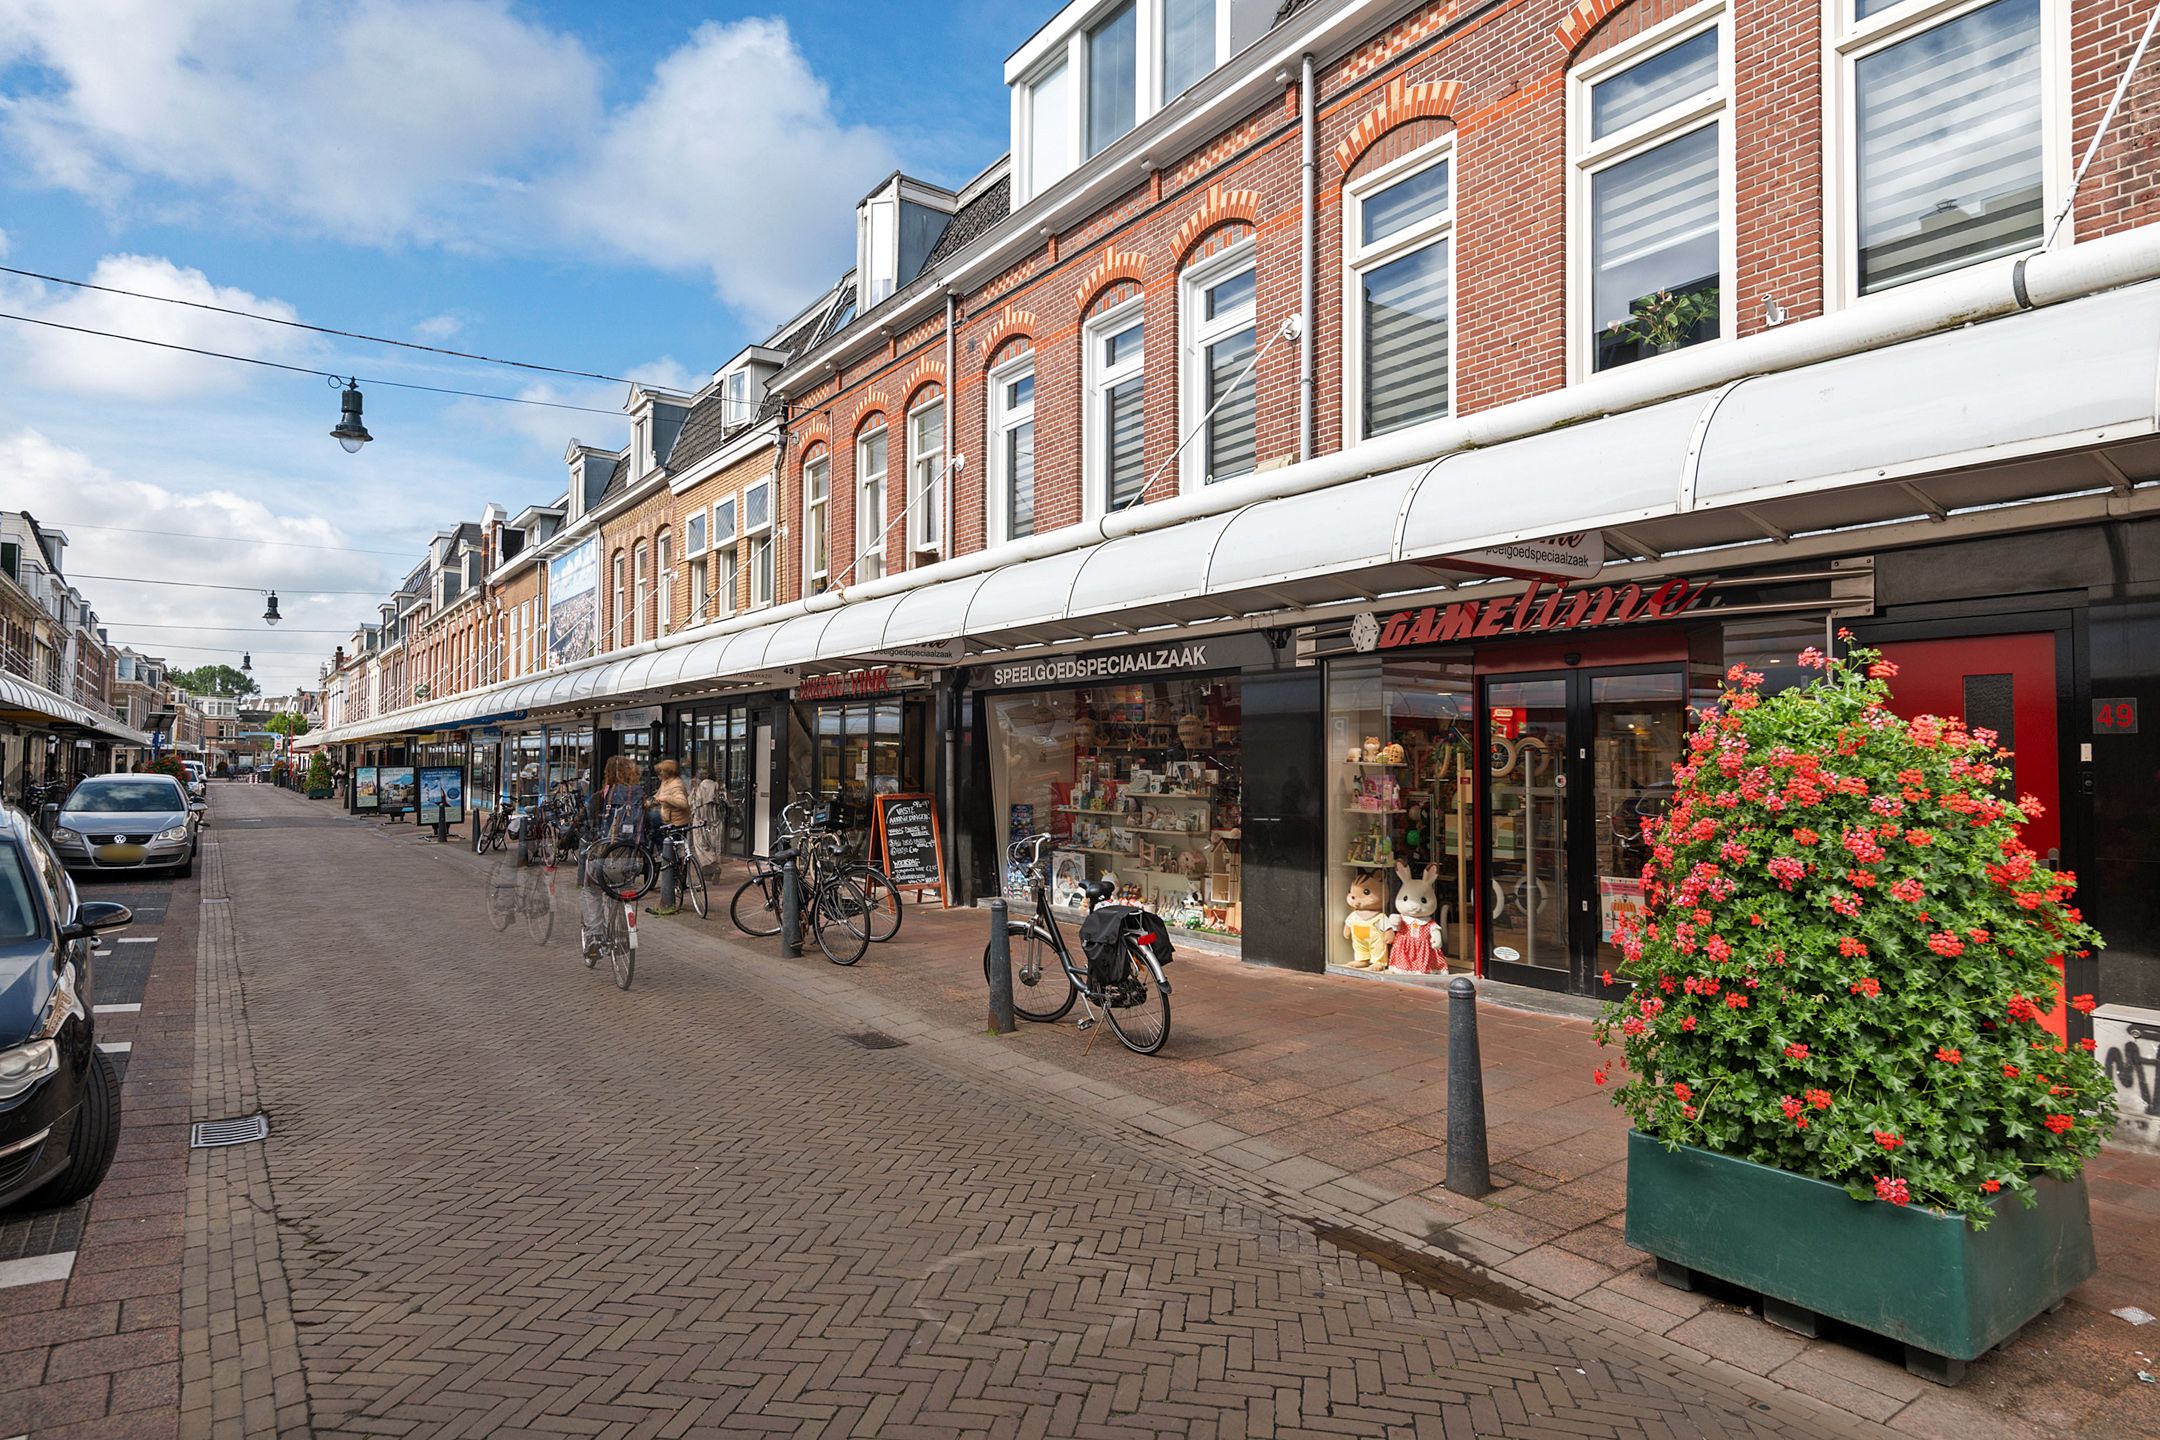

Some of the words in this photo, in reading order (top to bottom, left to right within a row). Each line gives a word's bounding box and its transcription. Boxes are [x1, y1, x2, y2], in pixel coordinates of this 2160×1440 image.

[783, 667, 794, 675] 45
[994, 646, 1207, 685] SPEELGOEDSPECIAALZAAK
[849, 669, 890, 696] VINK
[2097, 704, 2133, 728] 49
